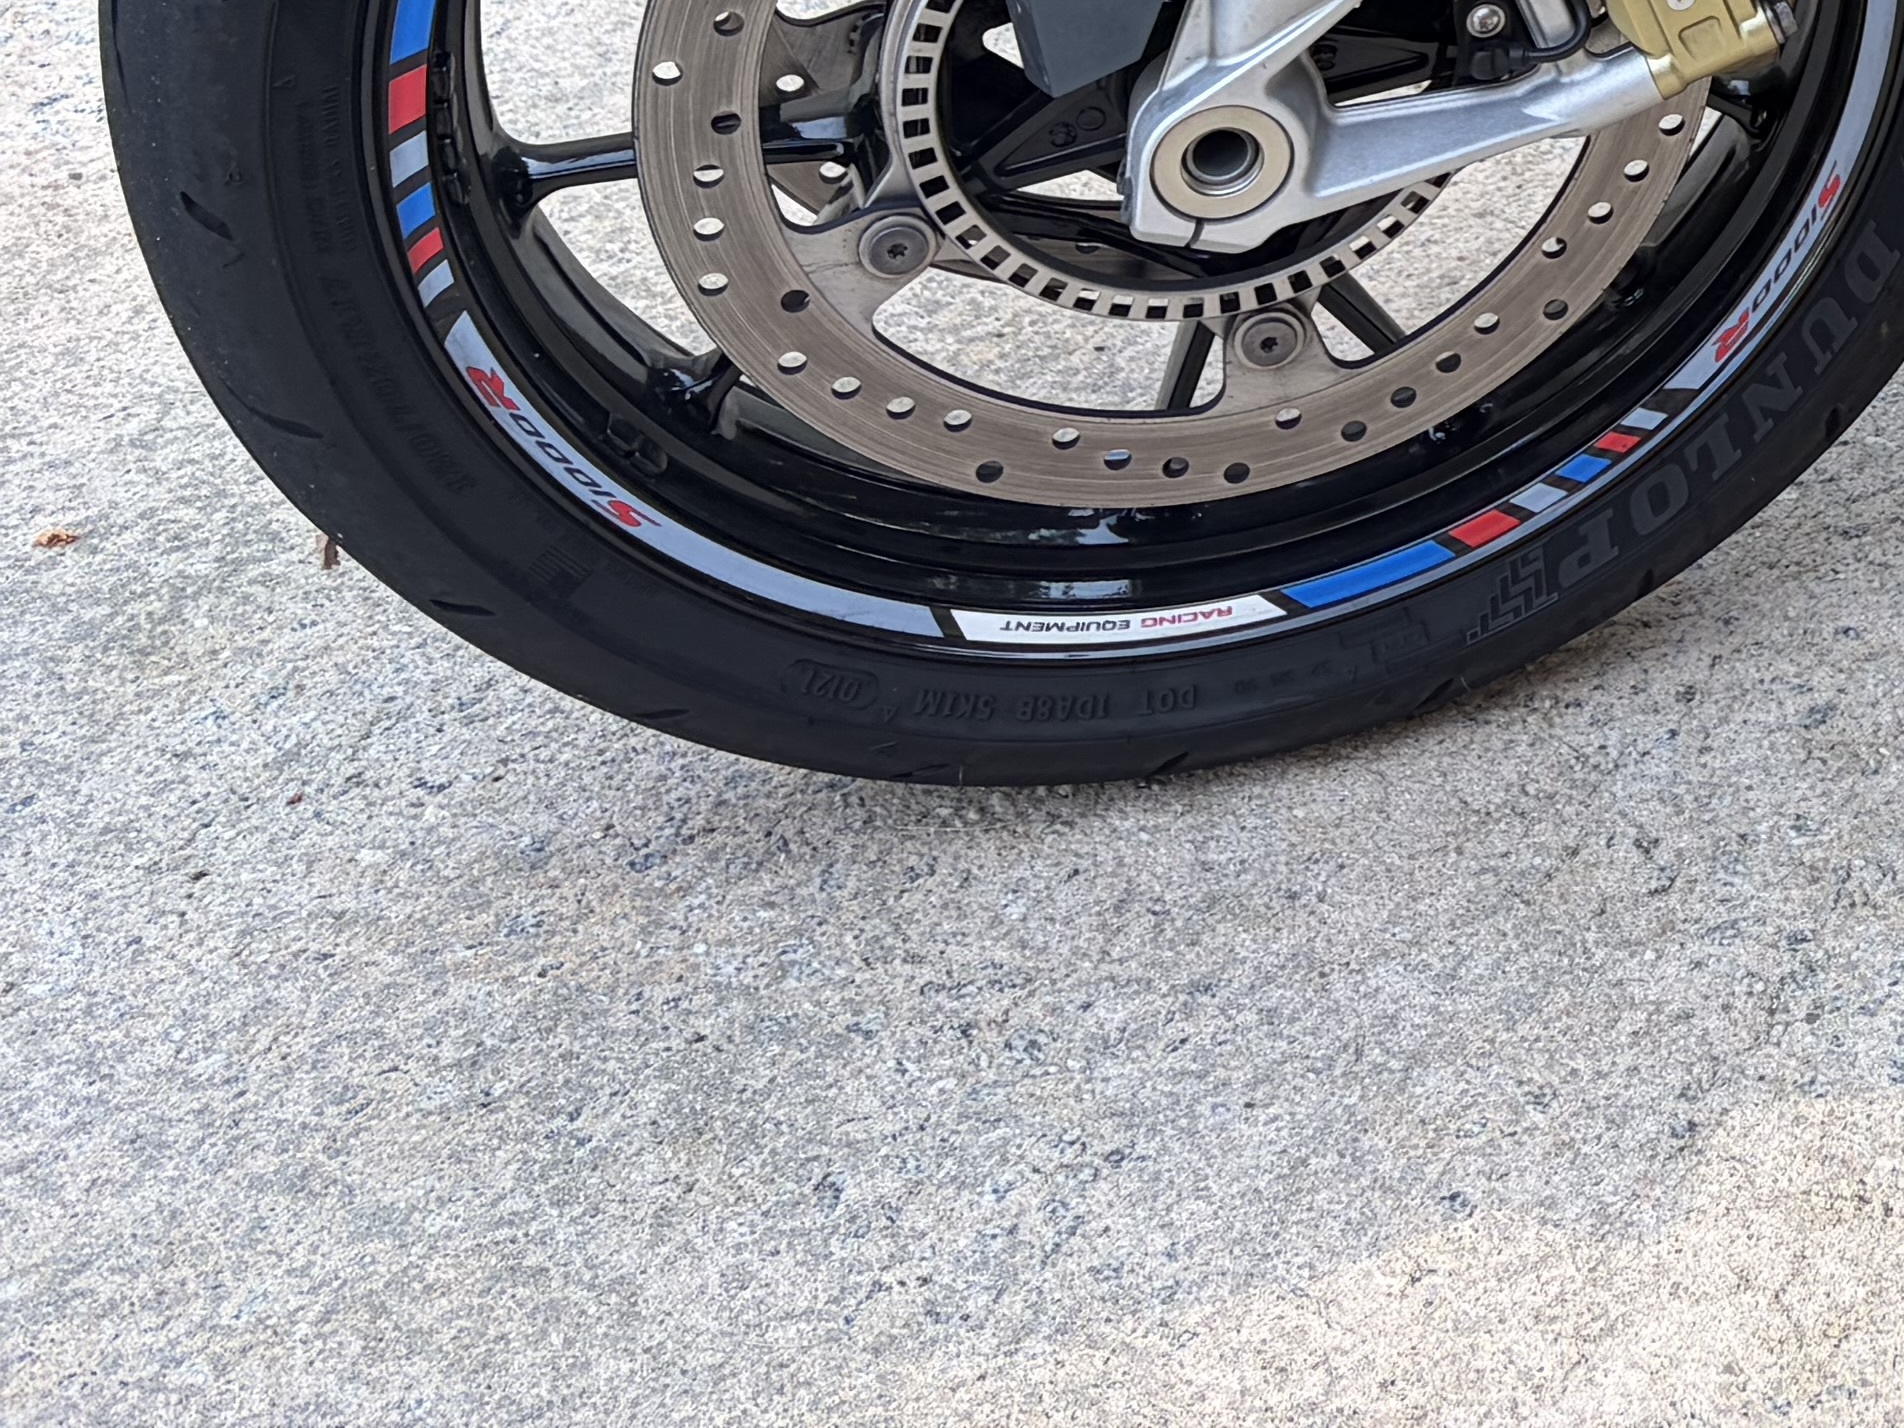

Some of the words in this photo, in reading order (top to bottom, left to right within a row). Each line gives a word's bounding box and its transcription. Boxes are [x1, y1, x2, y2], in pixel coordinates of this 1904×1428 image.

[1710, 162, 1842, 363] S1000R
[465, 365, 667, 529] S1000R
[997, 617, 1132, 635] EQUIPMENT
[1140, 605, 1234, 630] RACING
[1136, 683, 1199, 717] DOT
